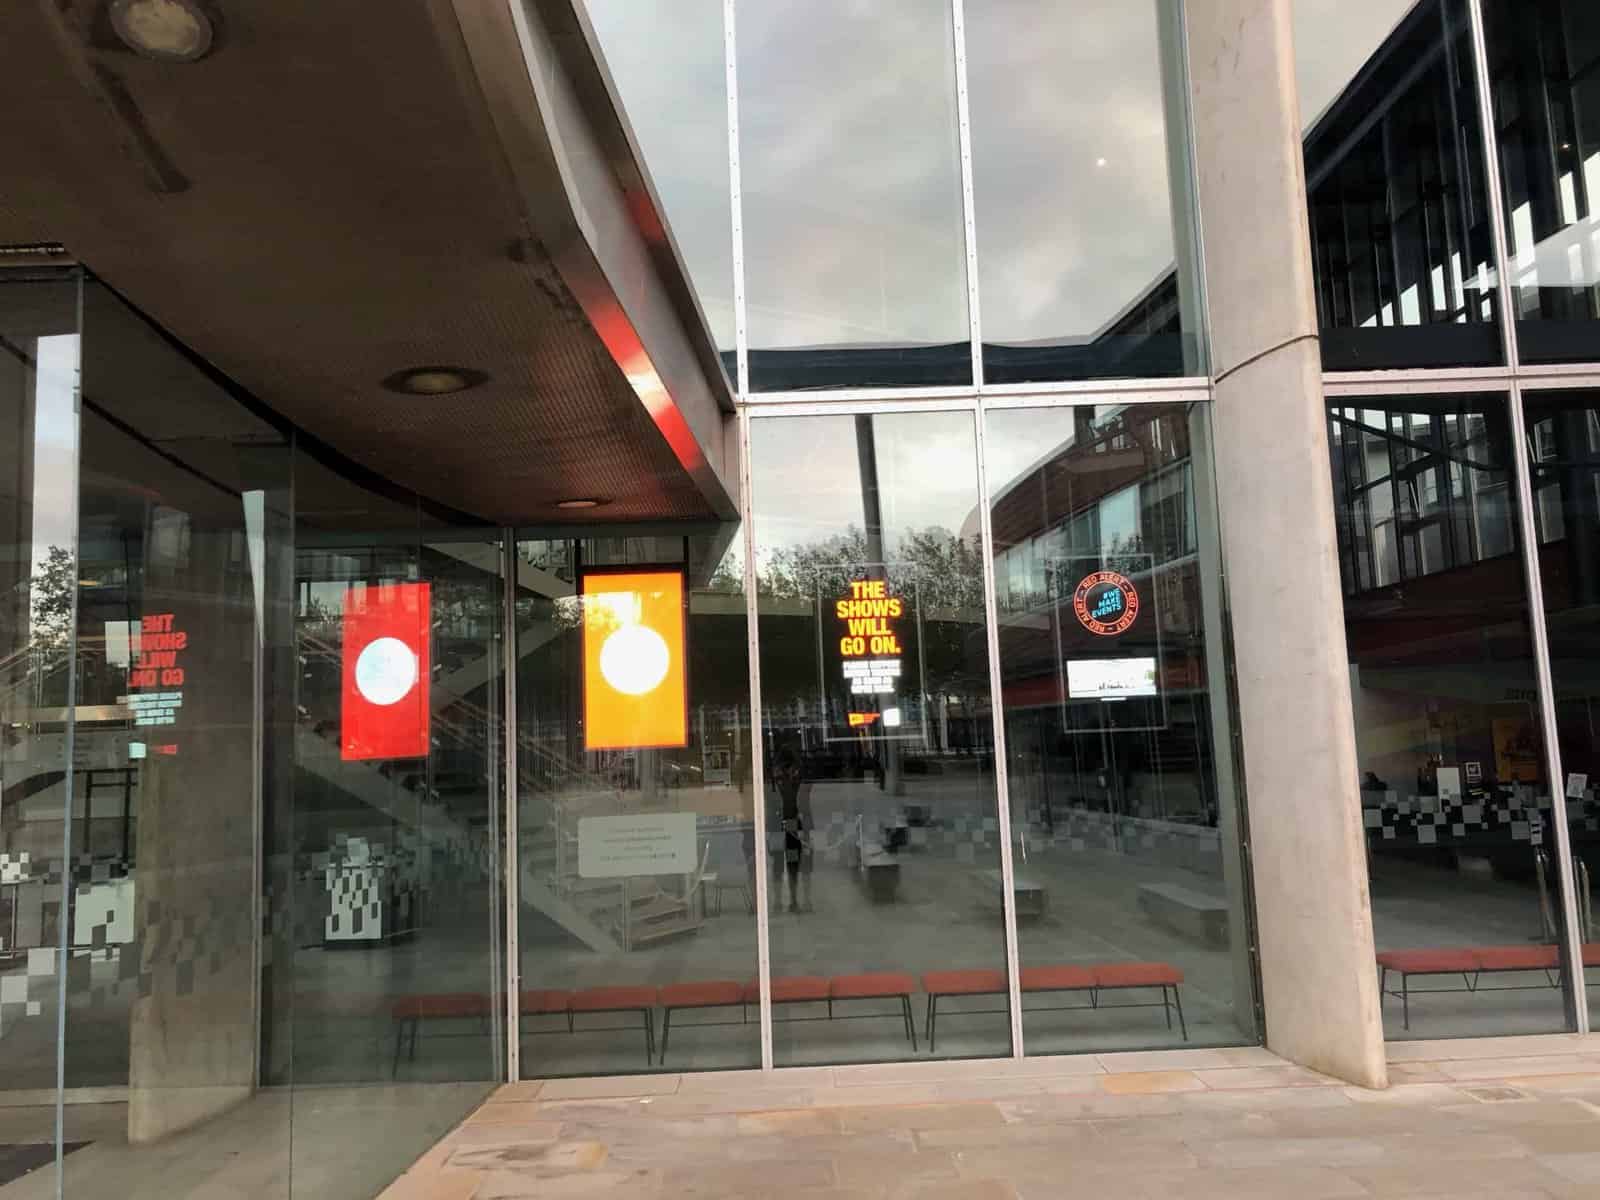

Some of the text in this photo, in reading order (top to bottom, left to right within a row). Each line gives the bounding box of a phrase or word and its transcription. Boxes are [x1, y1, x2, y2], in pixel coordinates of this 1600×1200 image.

[850, 580, 885, 599] THE
[1103, 588, 1121, 599] #WE
[836, 599, 902, 619] SHOWS
[1098, 596, 1121, 607] MAKE
[1091, 604, 1122, 619] EVENTS
[847, 618, 892, 636] WILL
[840, 636, 902, 655] GO ON.
